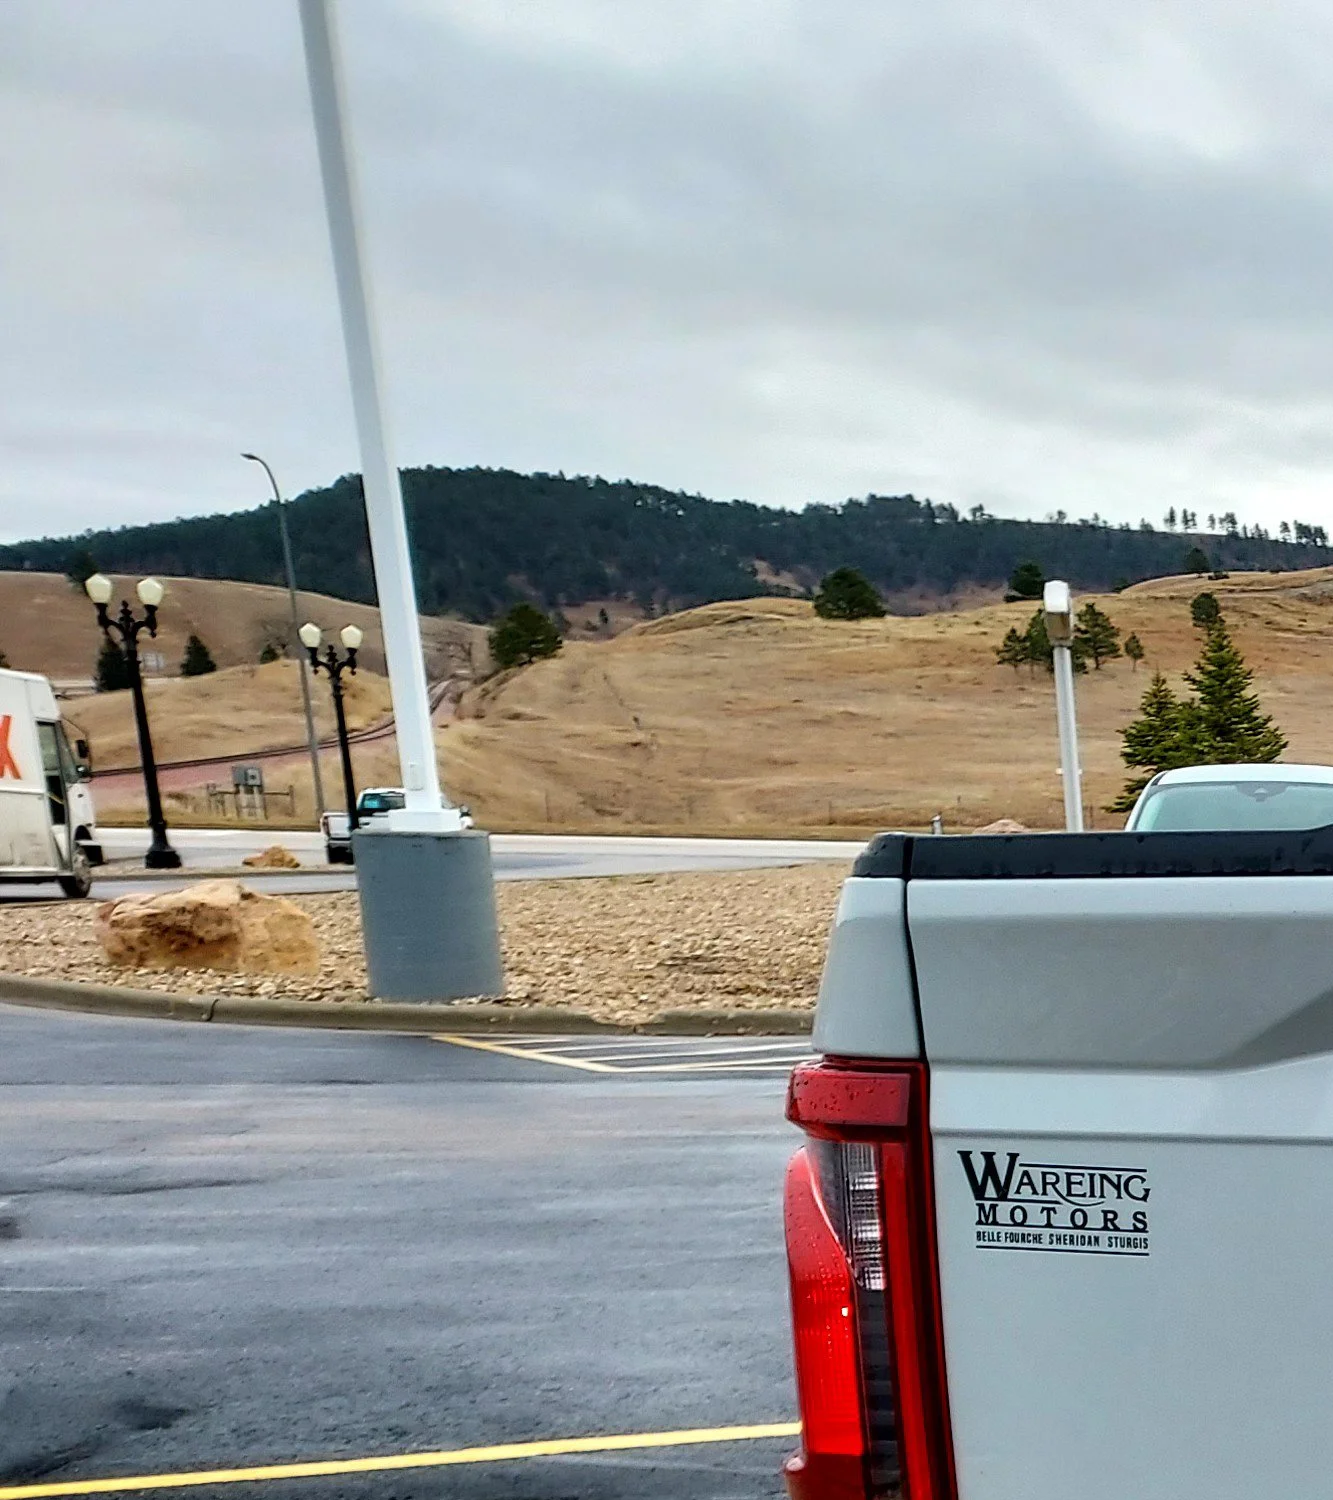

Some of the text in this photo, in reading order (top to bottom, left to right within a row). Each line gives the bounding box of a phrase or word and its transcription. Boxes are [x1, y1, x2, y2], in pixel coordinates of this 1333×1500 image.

[957, 1150, 1150, 1206] WAREING
[975, 1203, 1149, 1232] MOTORS
[976, 1231, 1149, 1249] BELLE FOURCHE SHERIDAN STURGIS
